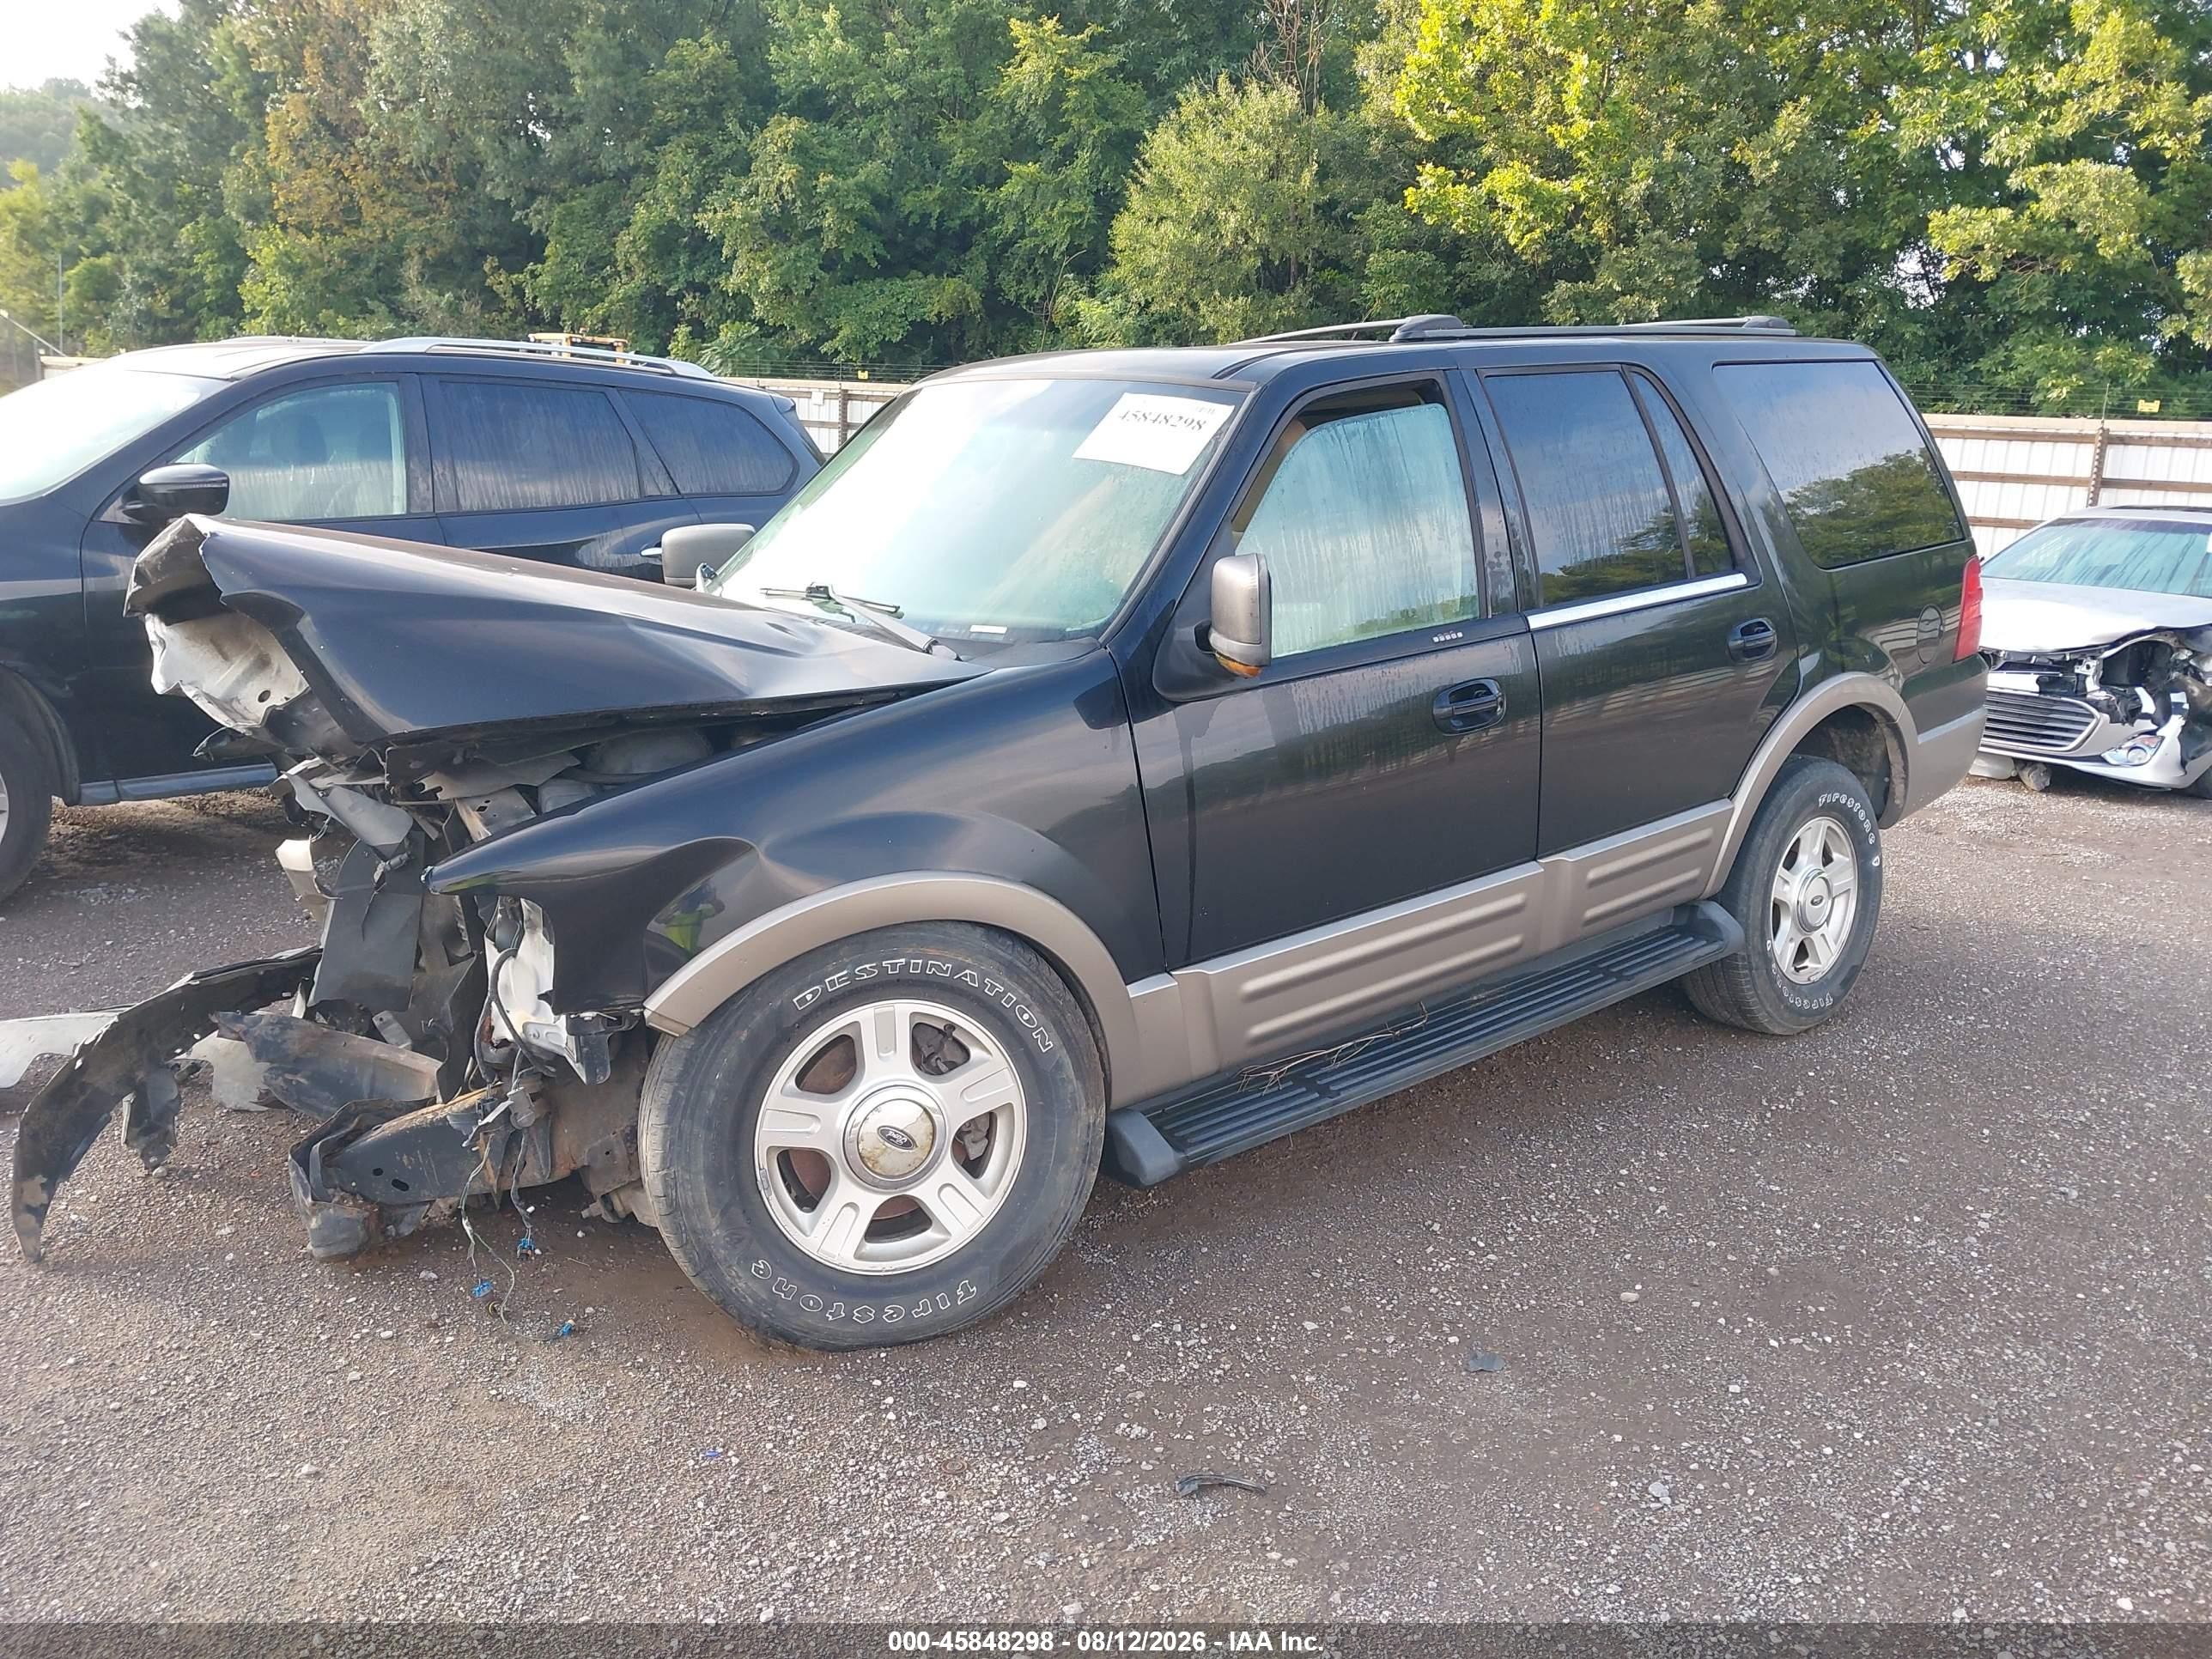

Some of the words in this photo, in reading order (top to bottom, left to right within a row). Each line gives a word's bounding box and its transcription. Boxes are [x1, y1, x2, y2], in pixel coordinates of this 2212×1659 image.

[1118, 410, 1207, 431] 45848298
[1818, 792, 1875, 845] Firestone
[792, 957, 1054, 1054] DESTINATION
[750, 1259, 977, 1324] Firestone
